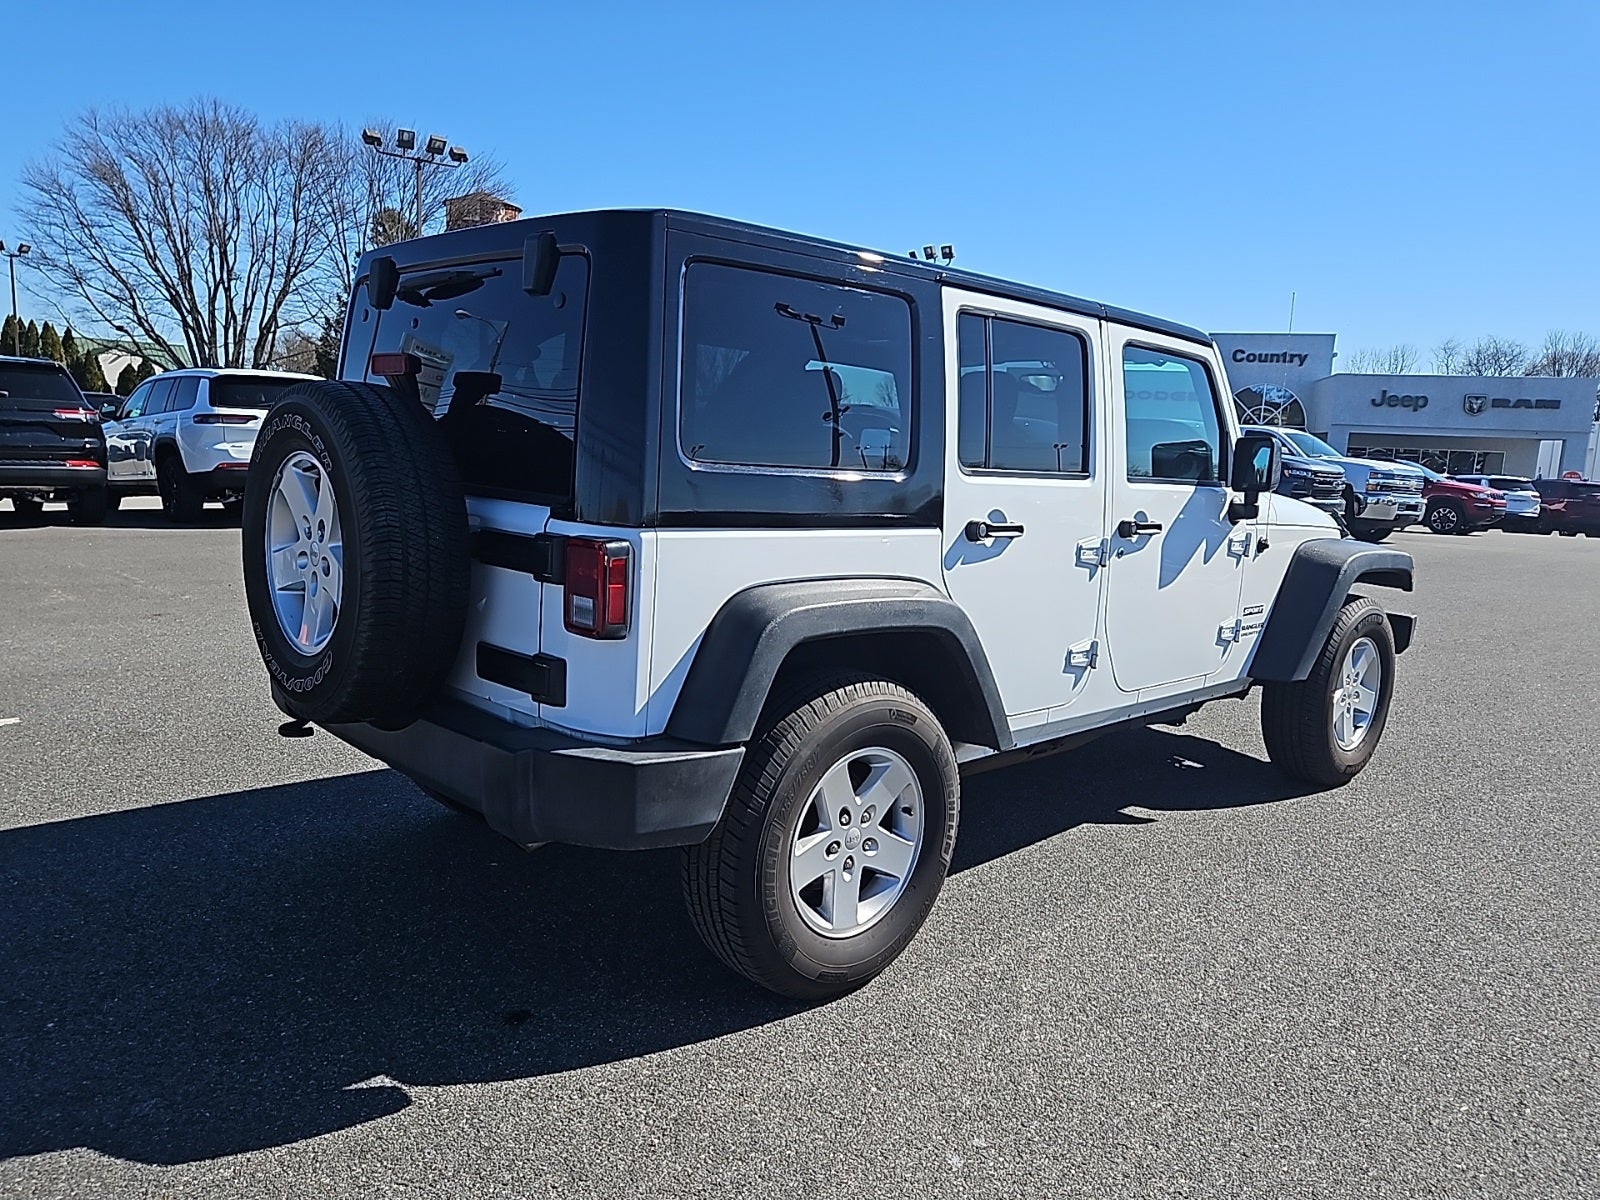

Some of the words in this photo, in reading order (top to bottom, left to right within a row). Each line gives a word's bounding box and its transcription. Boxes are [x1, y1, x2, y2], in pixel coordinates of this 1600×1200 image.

[1232, 349, 1309, 367] Country
[1371, 390, 1429, 412] Jeep
[1491, 398, 1562, 410] RAM
[254, 413, 333, 472] WRANGLER
[254, 621, 333, 693] GOODYEAR
